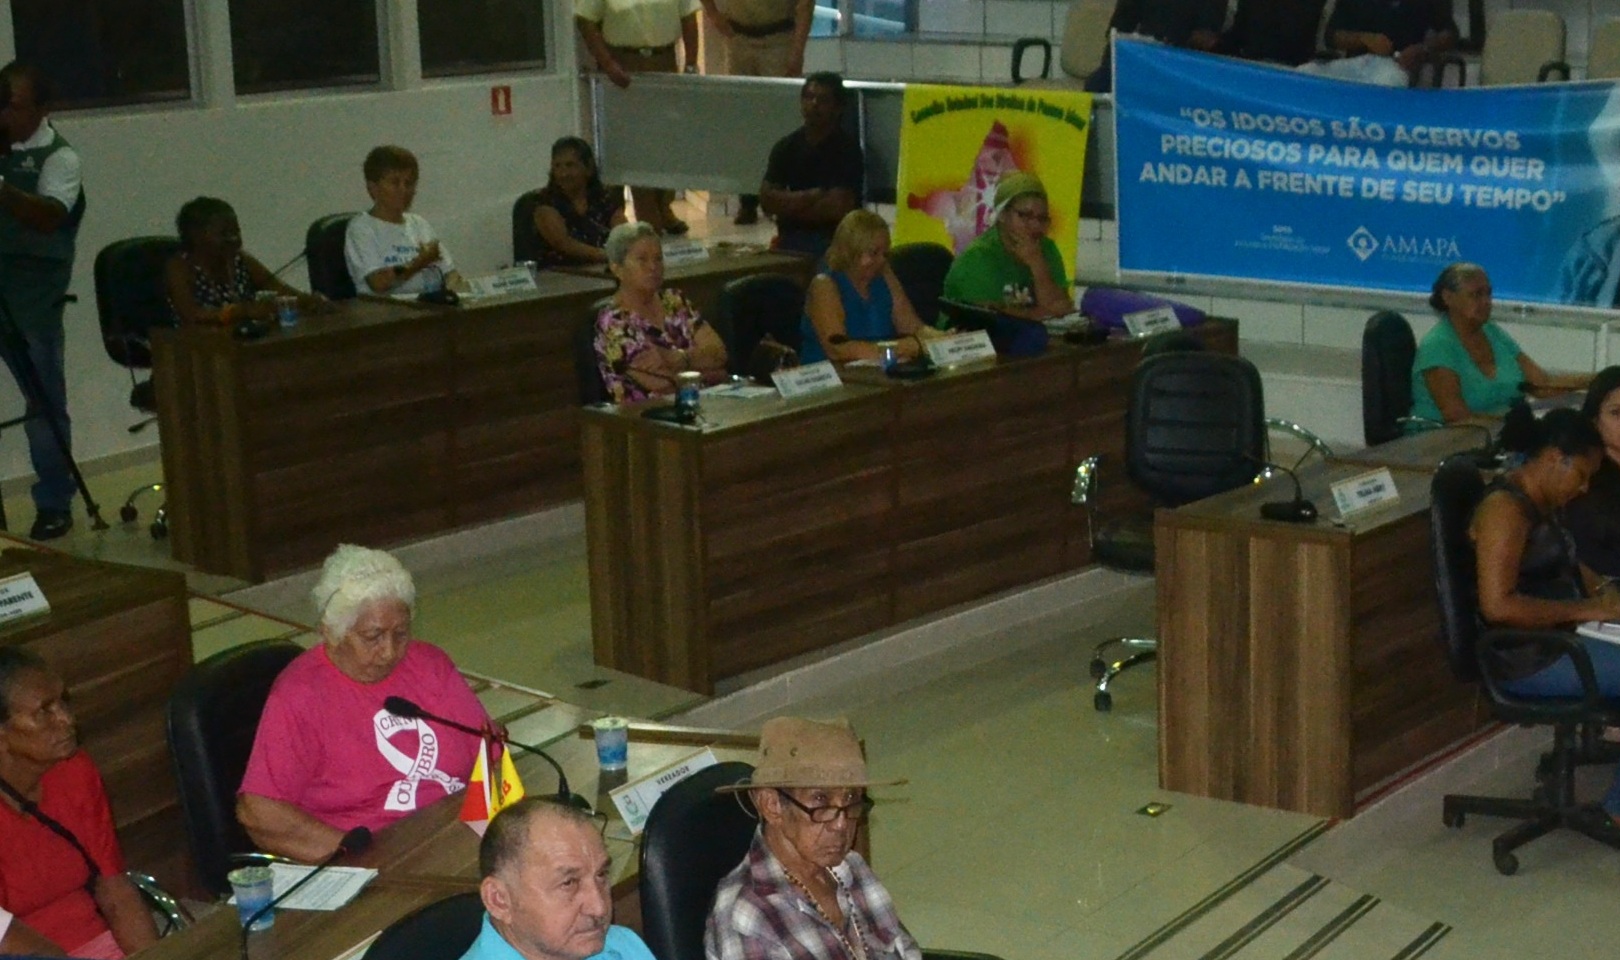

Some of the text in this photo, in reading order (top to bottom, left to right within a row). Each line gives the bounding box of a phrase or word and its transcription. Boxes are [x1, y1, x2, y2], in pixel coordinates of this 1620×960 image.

[1231, 111, 1326, 137] IDOSOS
[1330, 116, 1386, 142] SÃO
[1393, 124, 1521, 150] ACERVOS
[1160, 133, 1546, 181] PRECIOSOS PARA QUEM QUER
[1139, 161, 1228, 188] ANDAR
[1233, 168, 1253, 189] A
[1258, 169, 1355, 198] FRENTE
[1361, 176, 1397, 201] DE
[1402, 180, 1454, 205] SEU
[1382, 233, 1462, 258] AMAPÁ
